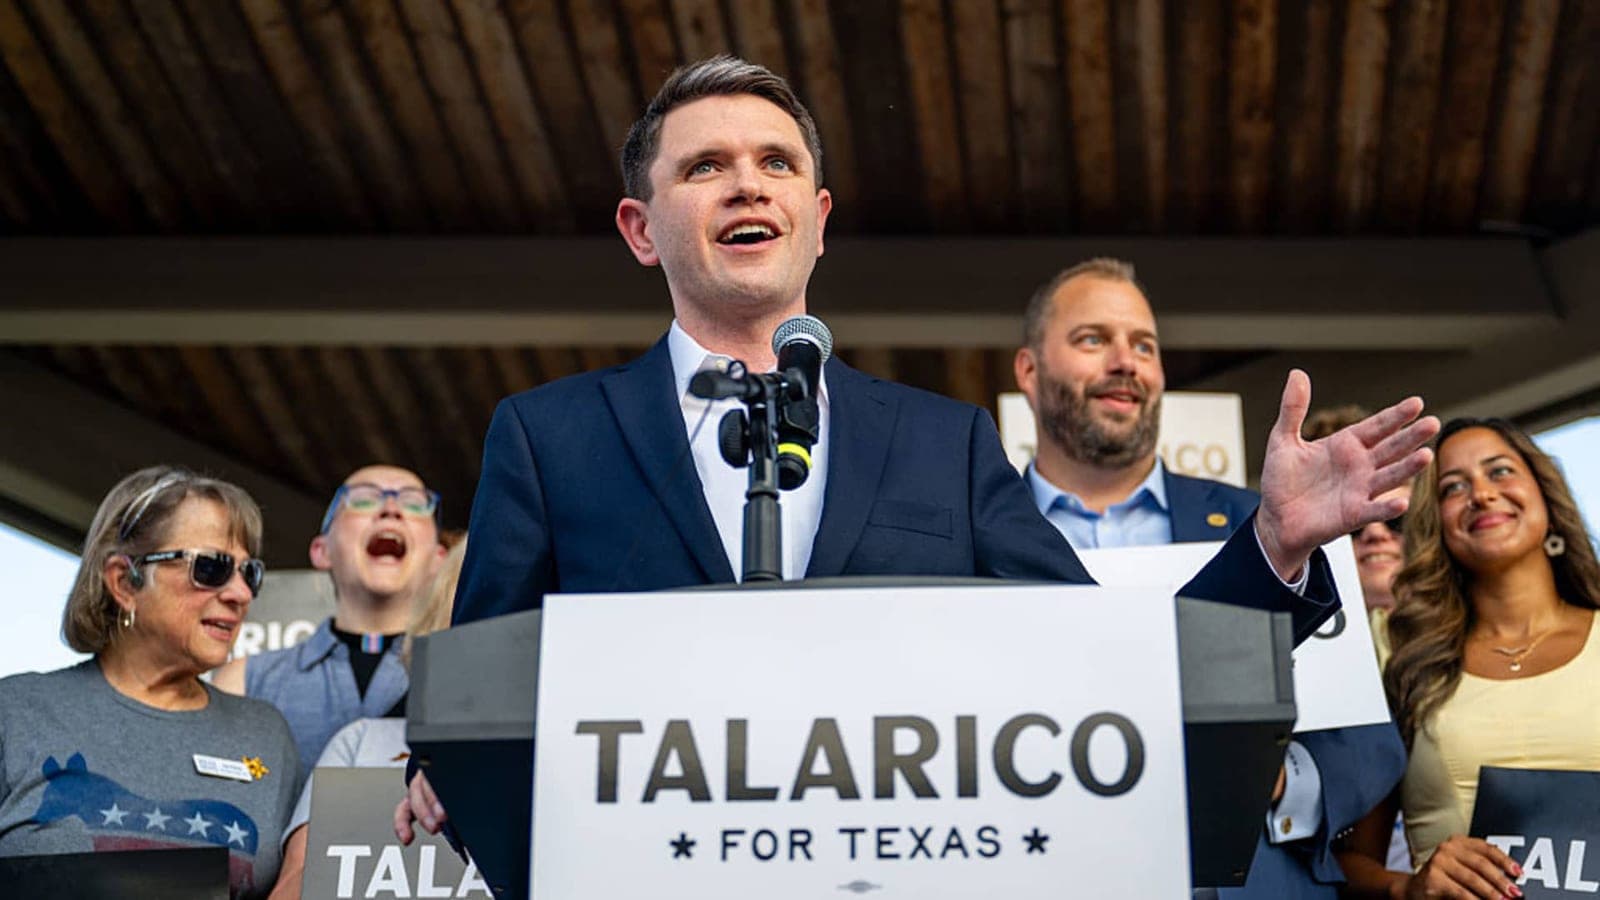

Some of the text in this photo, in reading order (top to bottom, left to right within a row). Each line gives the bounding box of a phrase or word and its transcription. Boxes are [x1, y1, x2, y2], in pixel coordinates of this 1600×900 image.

[575, 711, 1146, 803] TALARICO
[721, 826, 1002, 862] FOR TEXAS
